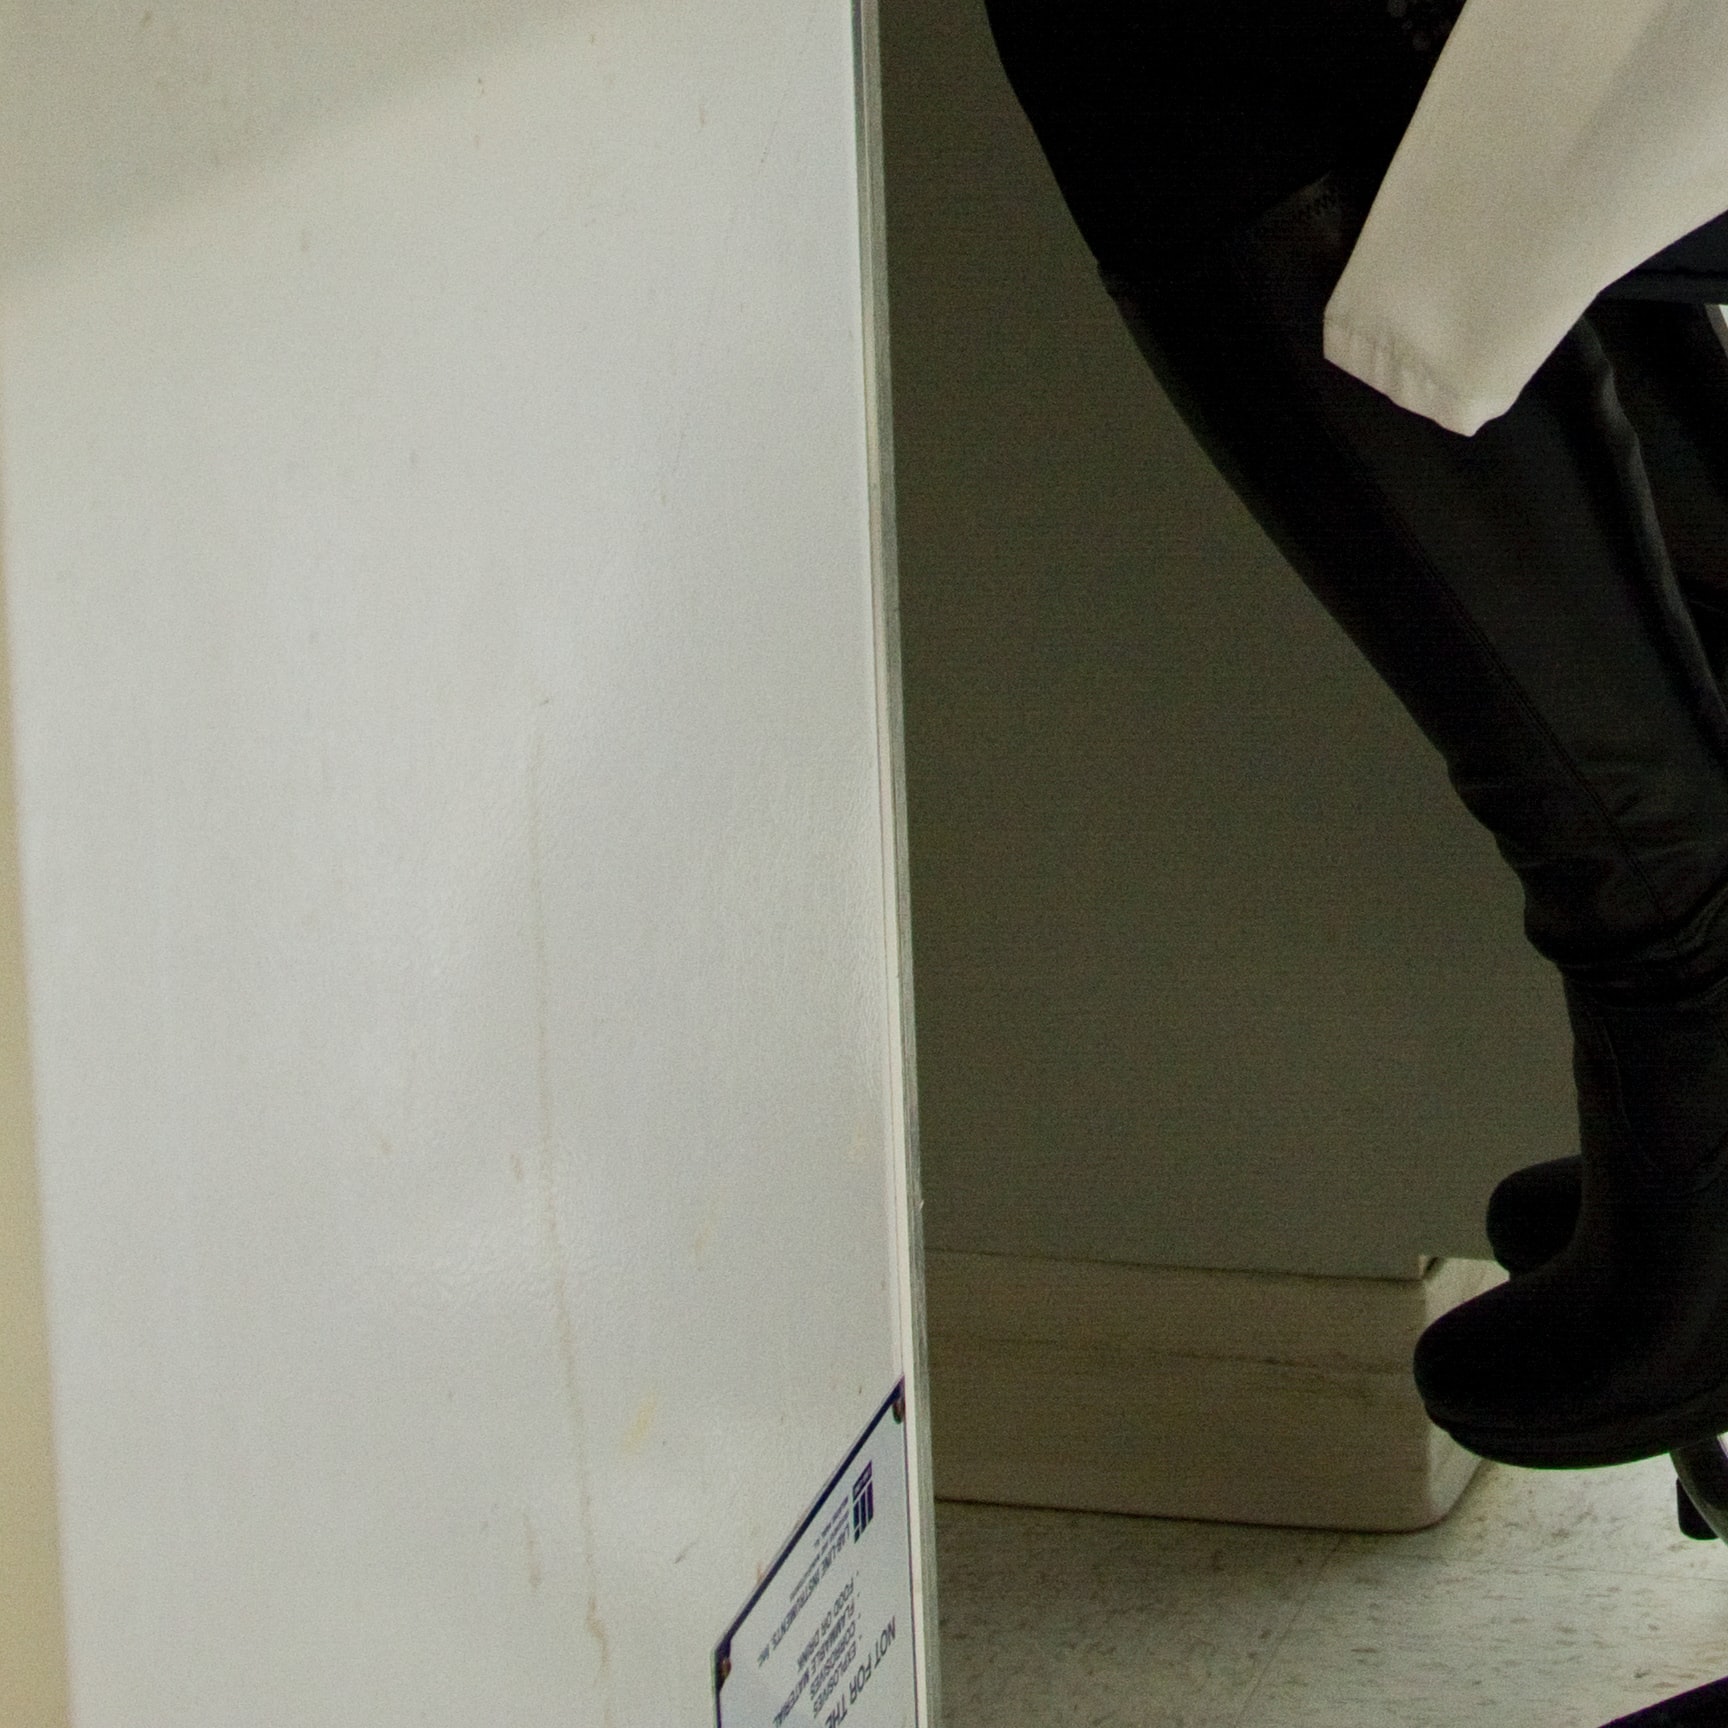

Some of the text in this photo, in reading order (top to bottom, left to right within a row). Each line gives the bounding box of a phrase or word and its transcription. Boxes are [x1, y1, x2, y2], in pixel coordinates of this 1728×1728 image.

[797, 1576, 854, 1672] FOOD OR DRINK
[810, 1619, 856, 1701] CORROSIVES
[811, 1597, 855, 1675] FLAMMABLE
[874, 1614, 896, 1669] NOT
[813, 1640, 857, 1719] EXPLOSIVES
[849, 1653, 872, 1705] FOR
